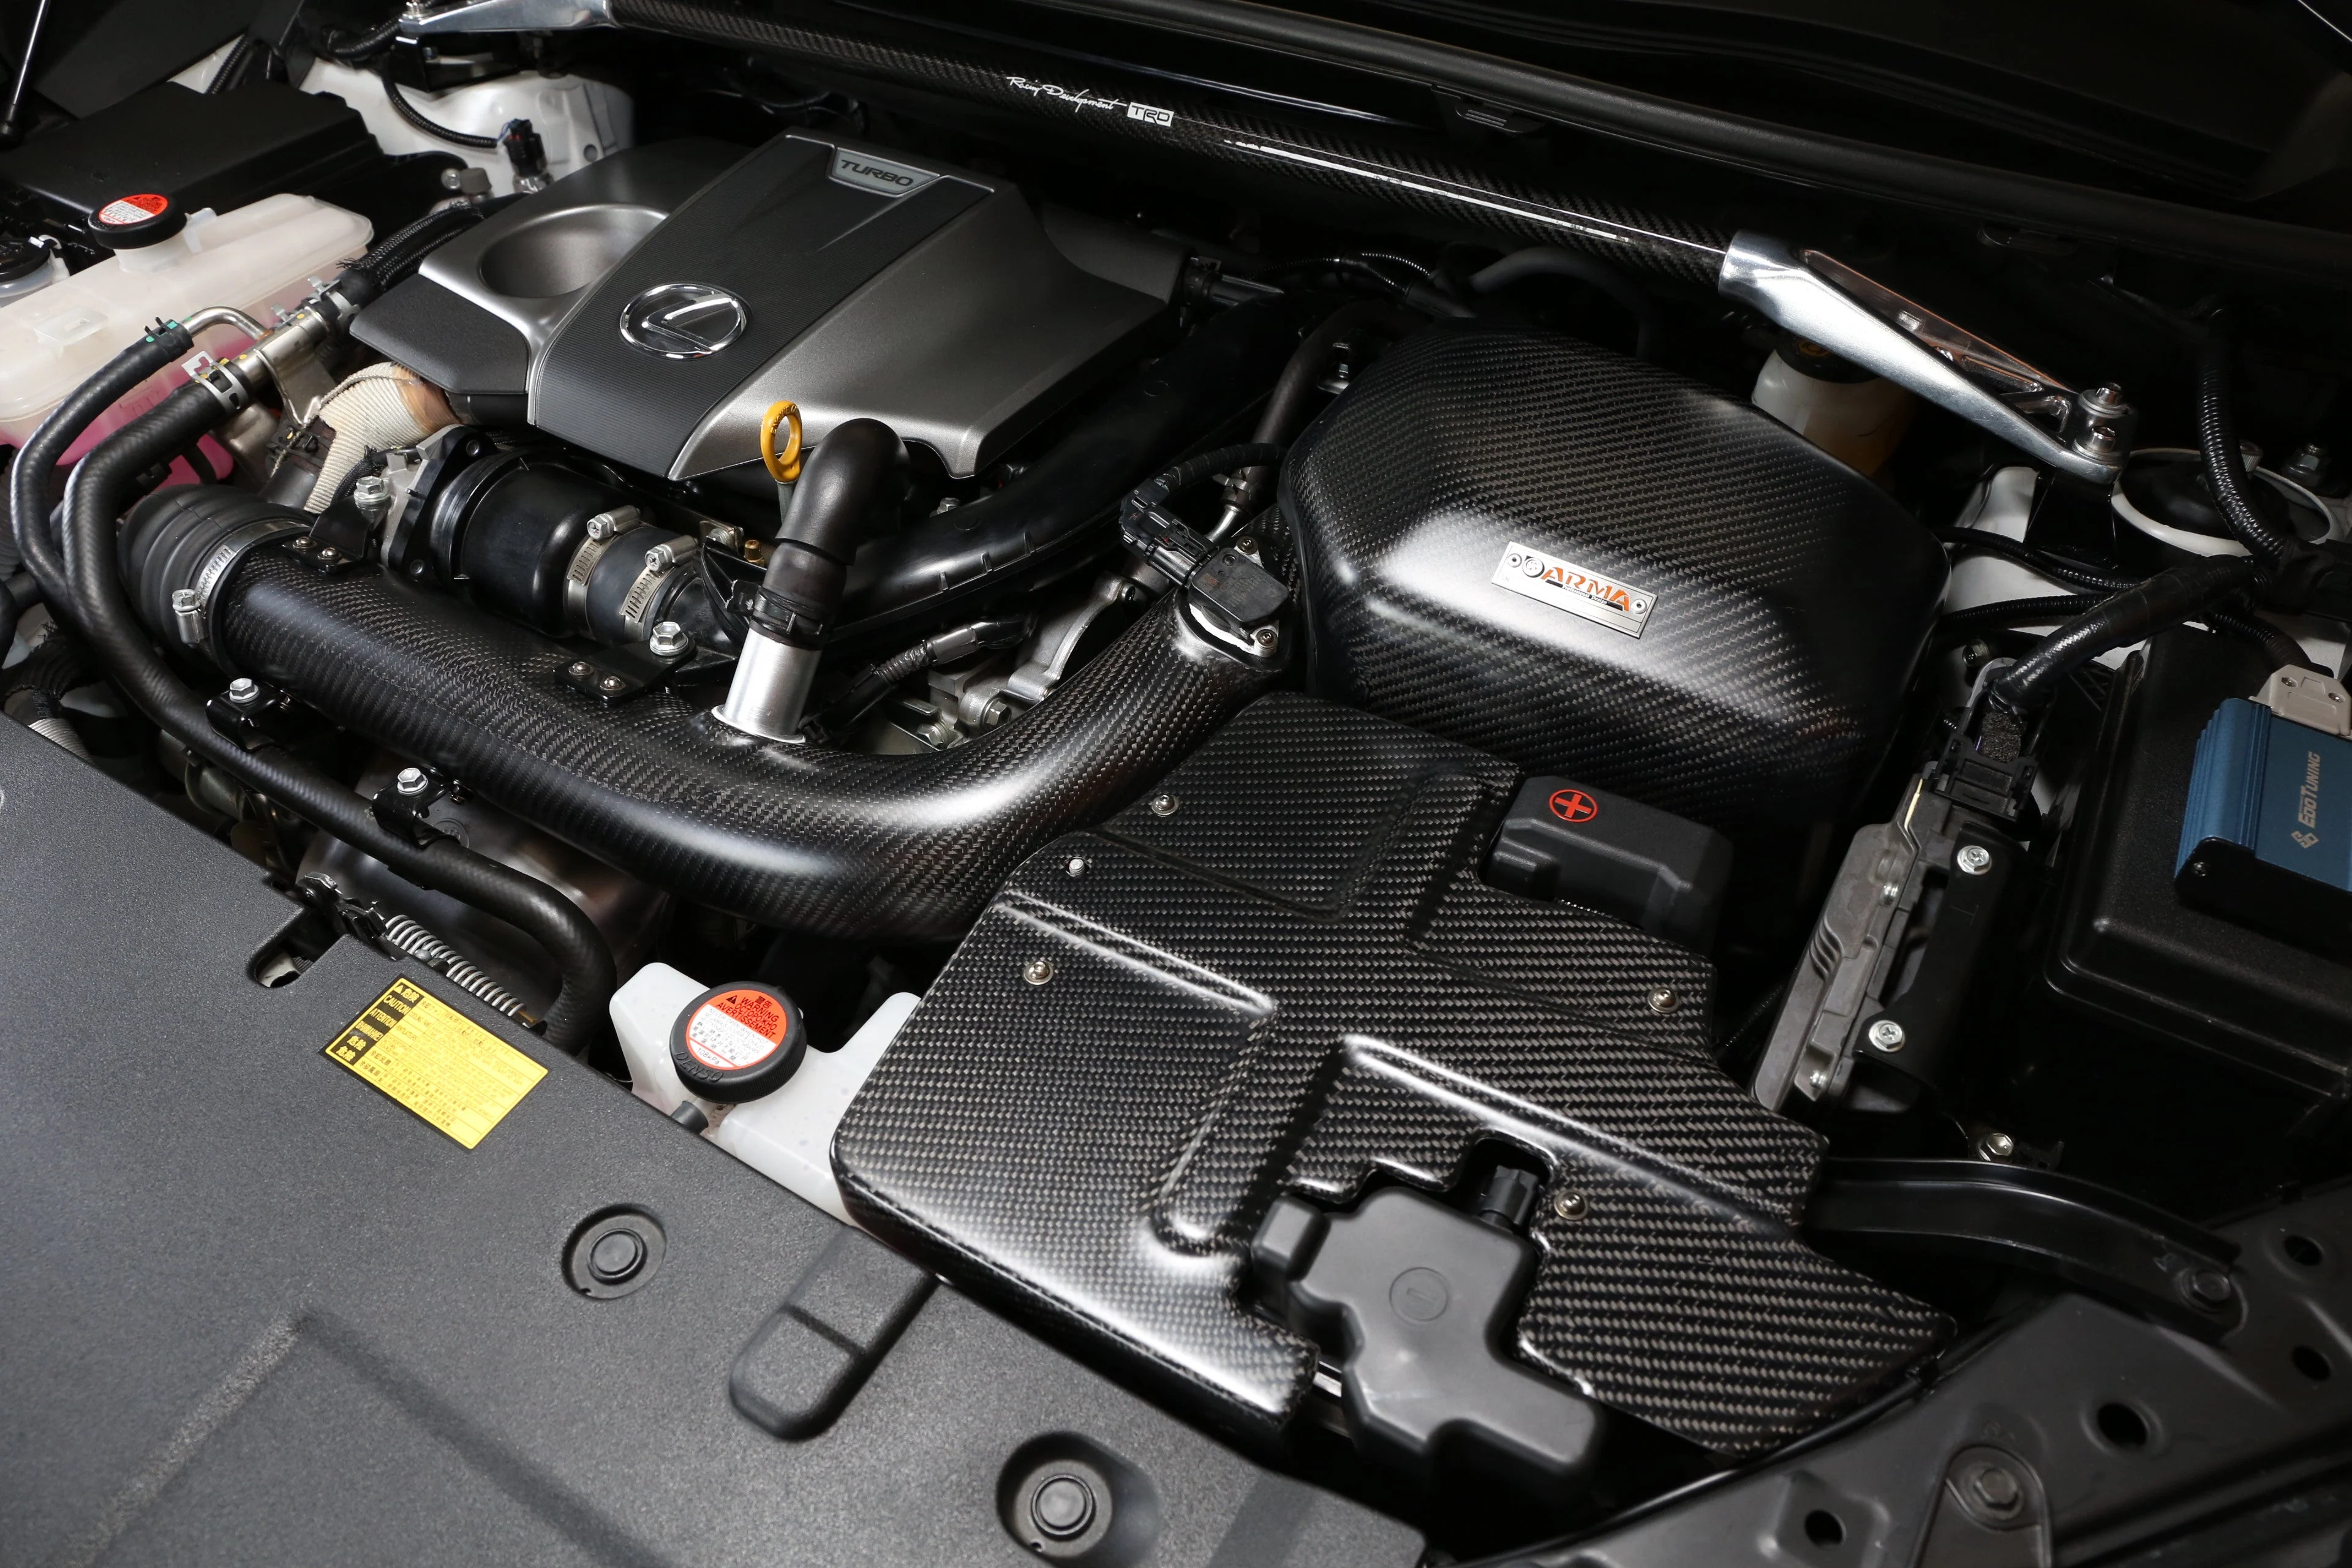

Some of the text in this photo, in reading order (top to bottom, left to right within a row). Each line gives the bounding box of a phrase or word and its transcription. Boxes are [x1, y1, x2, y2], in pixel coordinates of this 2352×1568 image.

[1006, 77, 1171, 124] Racing Development TRD
[841, 159, 914, 186] TURBO
[1540, 566, 1631, 611] ARMA
[1562, 585, 1608, 605] Professional Design
[368, 1007, 398, 1028] ATTENTION
[382, 993, 412, 1016] CAUTION
[734, 1001, 777, 1031] ОСТОРОЖНО
[741, 997, 780, 1023] WARNING
[715, 1001, 776, 1039] AVERTISSEMENT
[675, 1050, 725, 1083] DENSO
[696, 1047, 722, 1065] 108kPa
